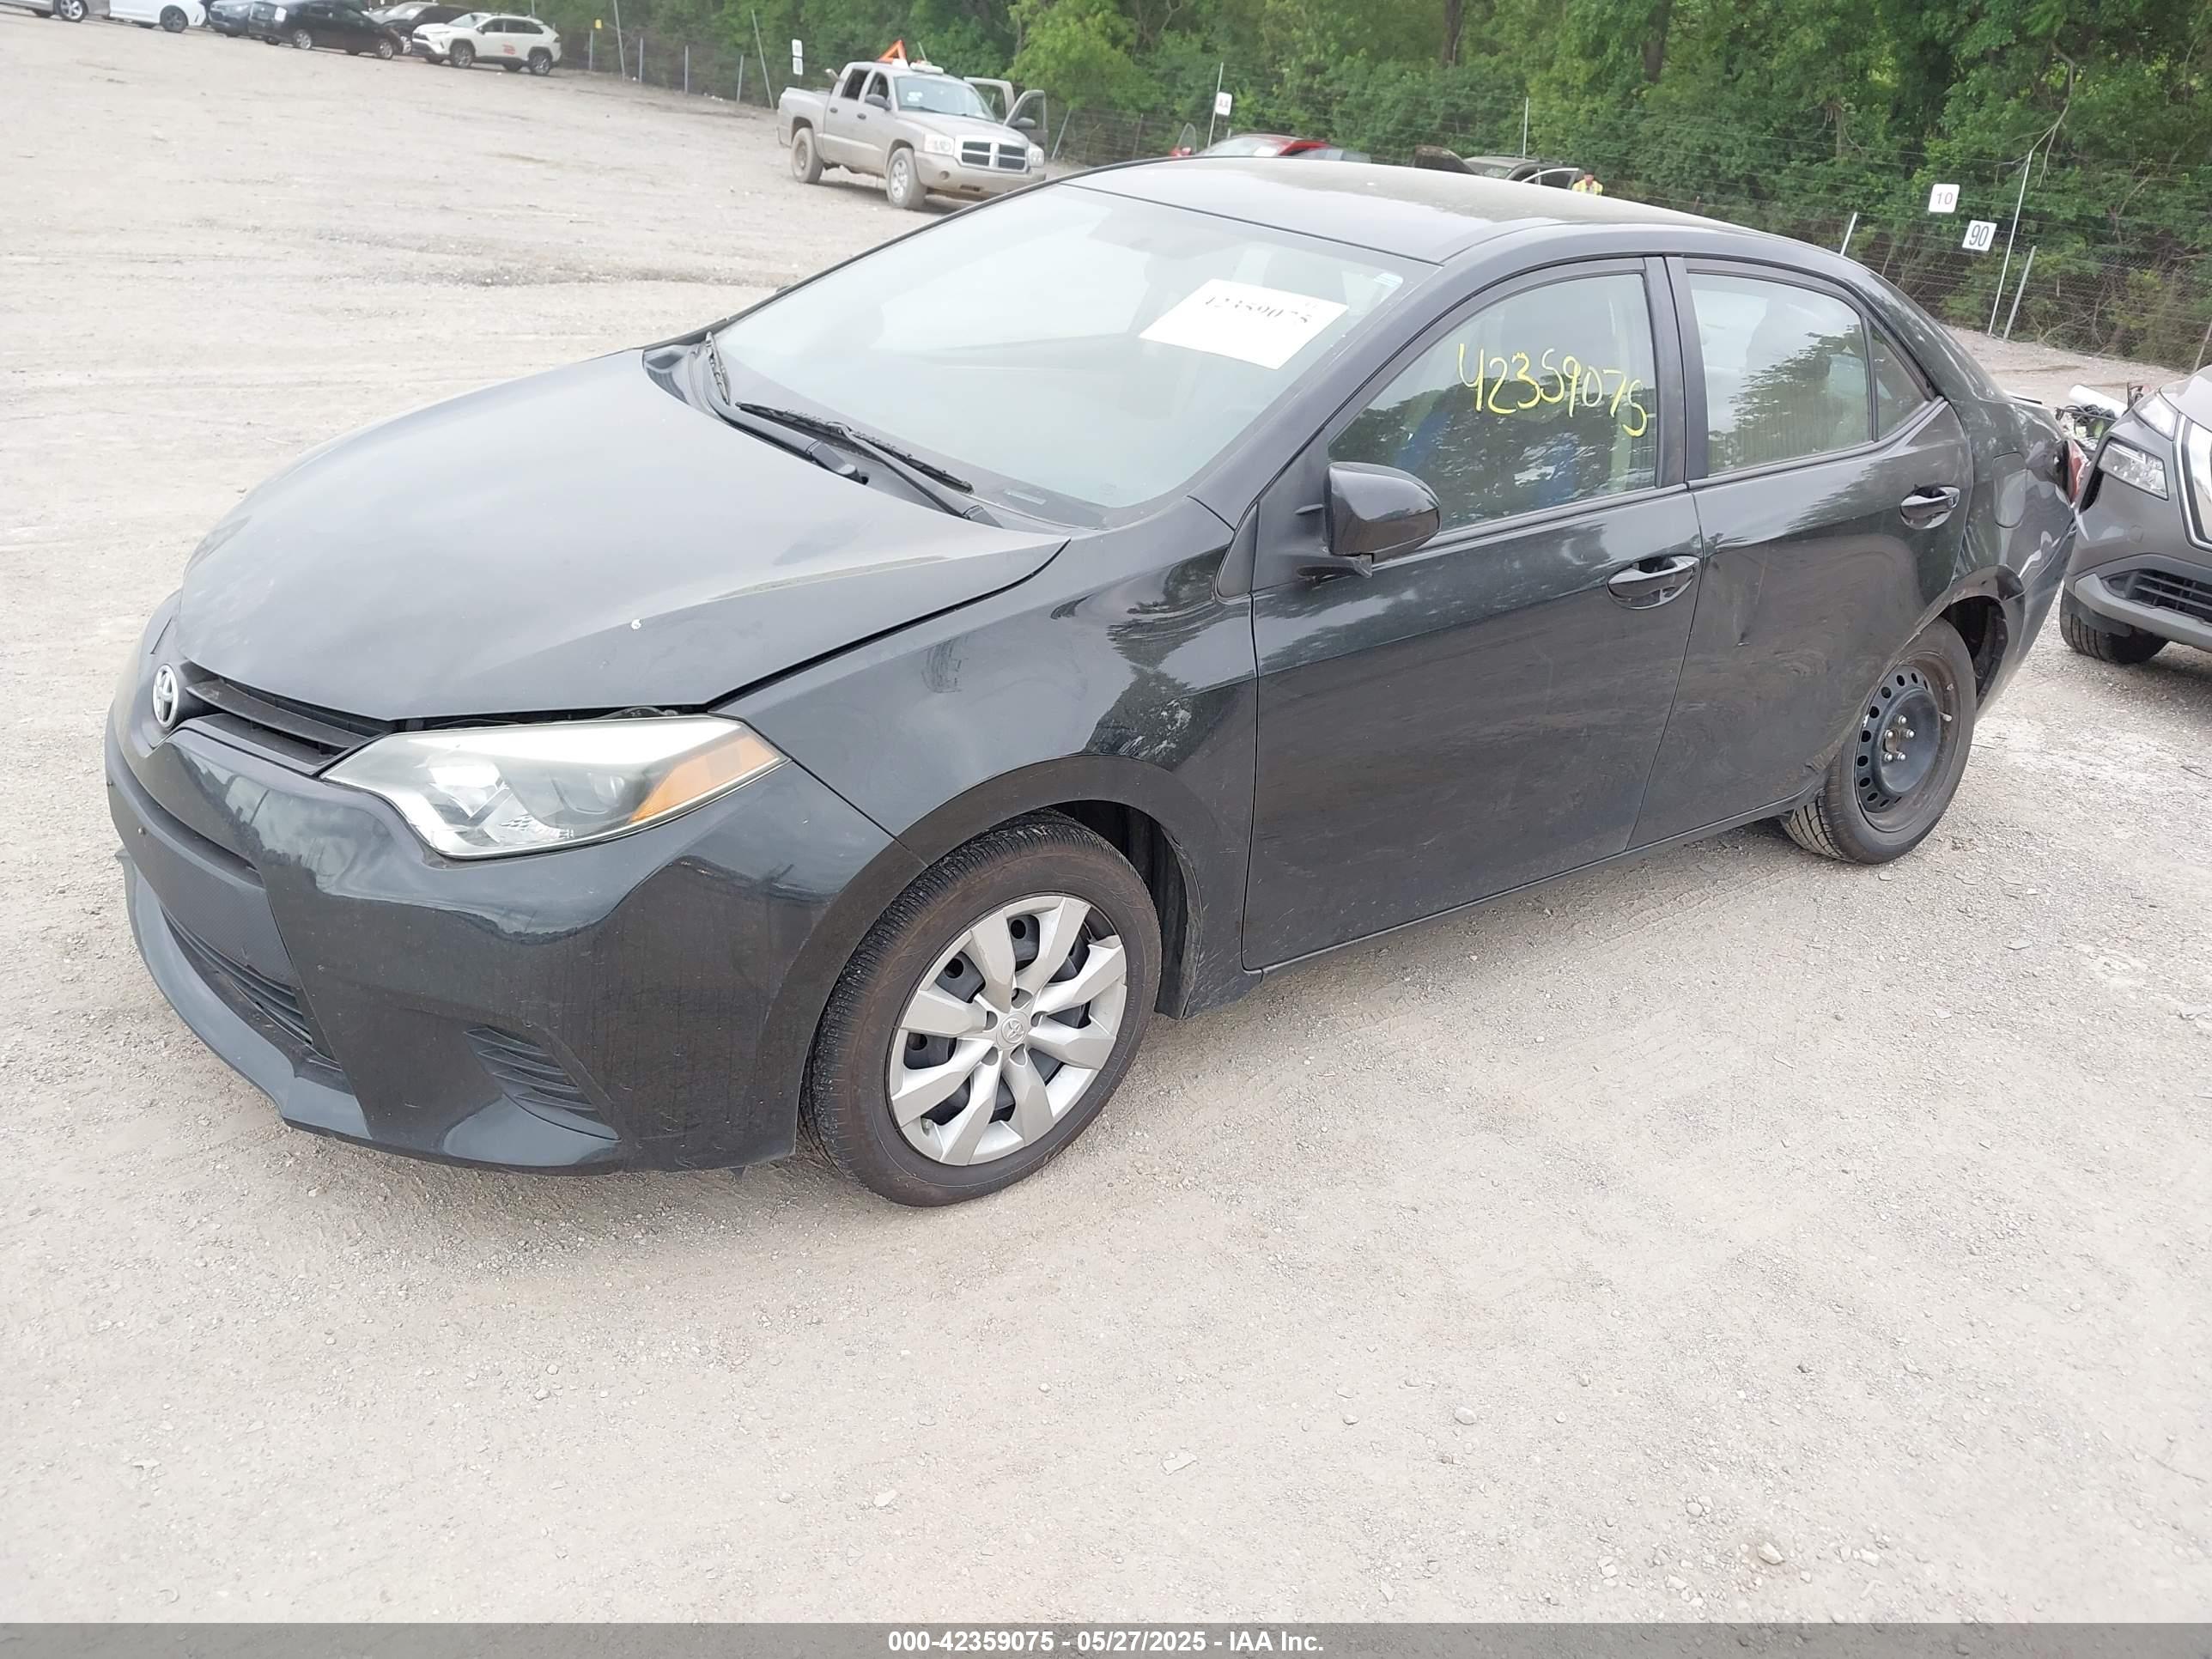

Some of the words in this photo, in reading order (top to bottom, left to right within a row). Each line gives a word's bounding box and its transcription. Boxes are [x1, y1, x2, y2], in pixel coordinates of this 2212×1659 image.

[1937, 191, 1954, 205] 10
[1968, 224, 1990, 247] 90
[1457, 343, 1650, 438] 42359075
